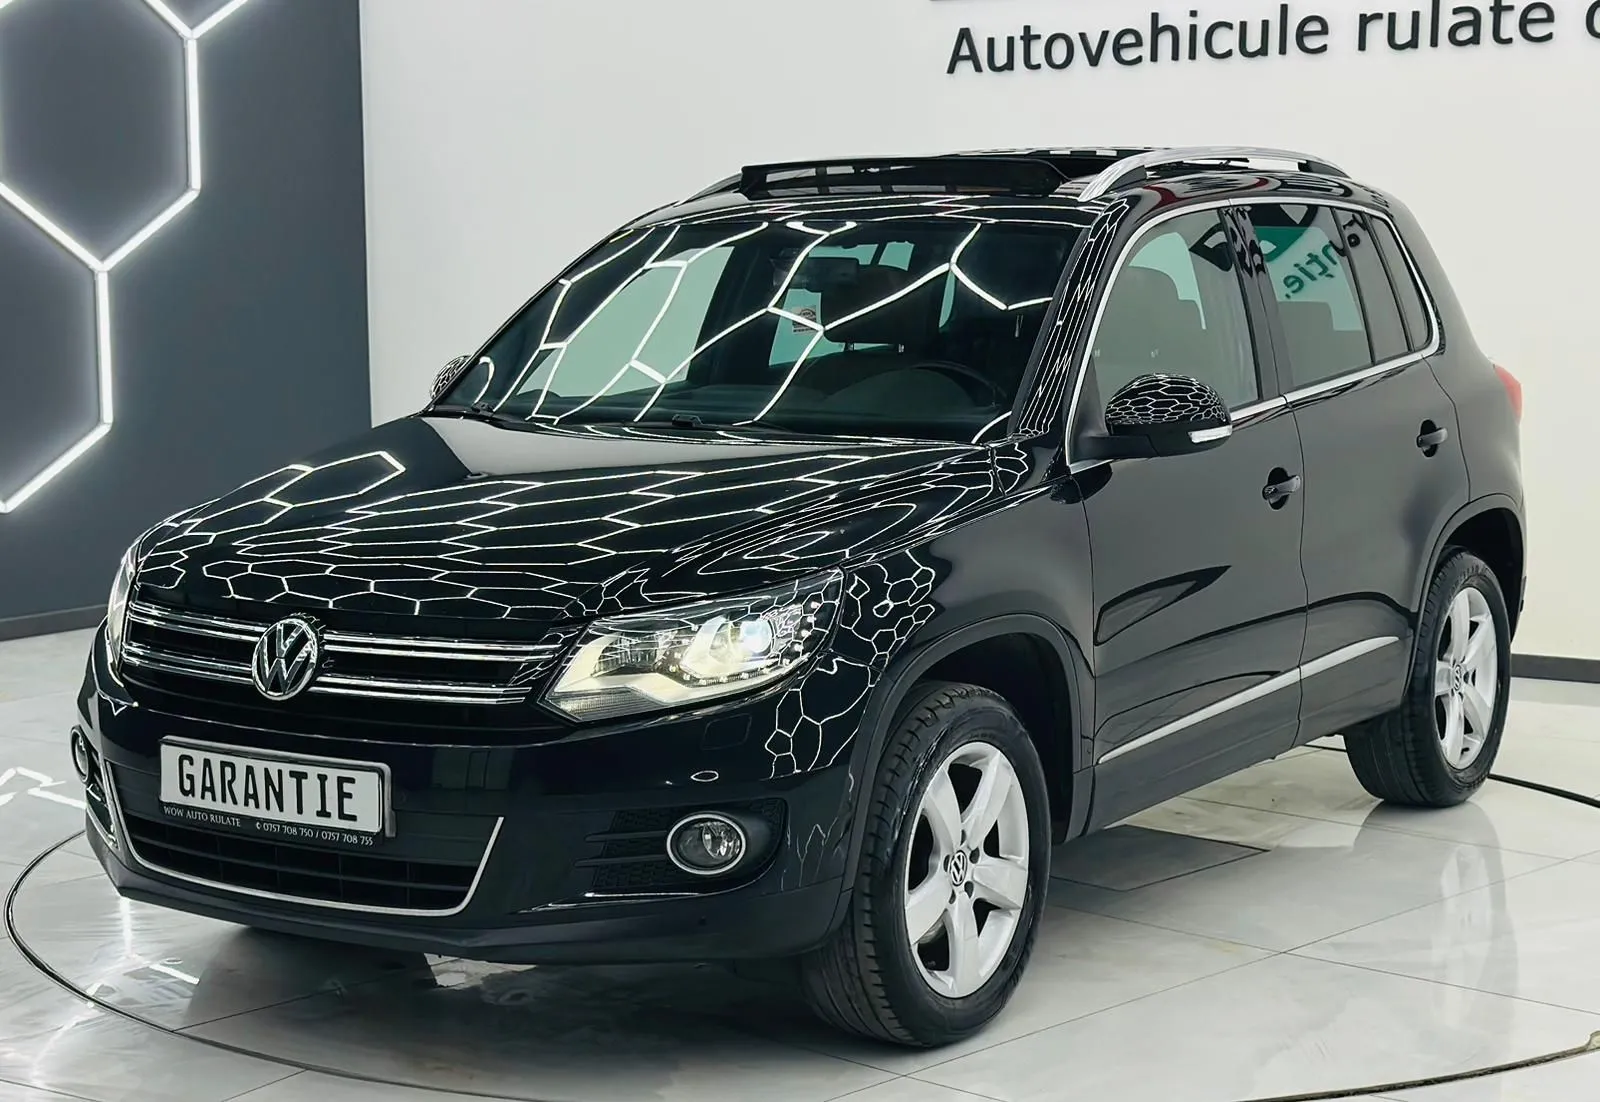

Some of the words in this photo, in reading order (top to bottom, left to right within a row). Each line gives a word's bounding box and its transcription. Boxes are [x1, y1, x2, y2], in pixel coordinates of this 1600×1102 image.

[947, 3, 1330, 74] Autovehicule
[1357, 0, 1556, 51] rulate
[252, 618, 318, 701] VW
[163, 805, 184, 817] WOW
[185, 810, 209, 822] AUTO
[209, 814, 241, 828] RULATE
[178, 754, 358, 822] GARANTIE
[263, 822, 280, 833] 0757
[281, 825, 298, 836] 708
[299, 827, 314, 838] 750
[321, 830, 340, 842] 0757
[341, 833, 358, 844] 708
[360, 835, 374, 847] 755
